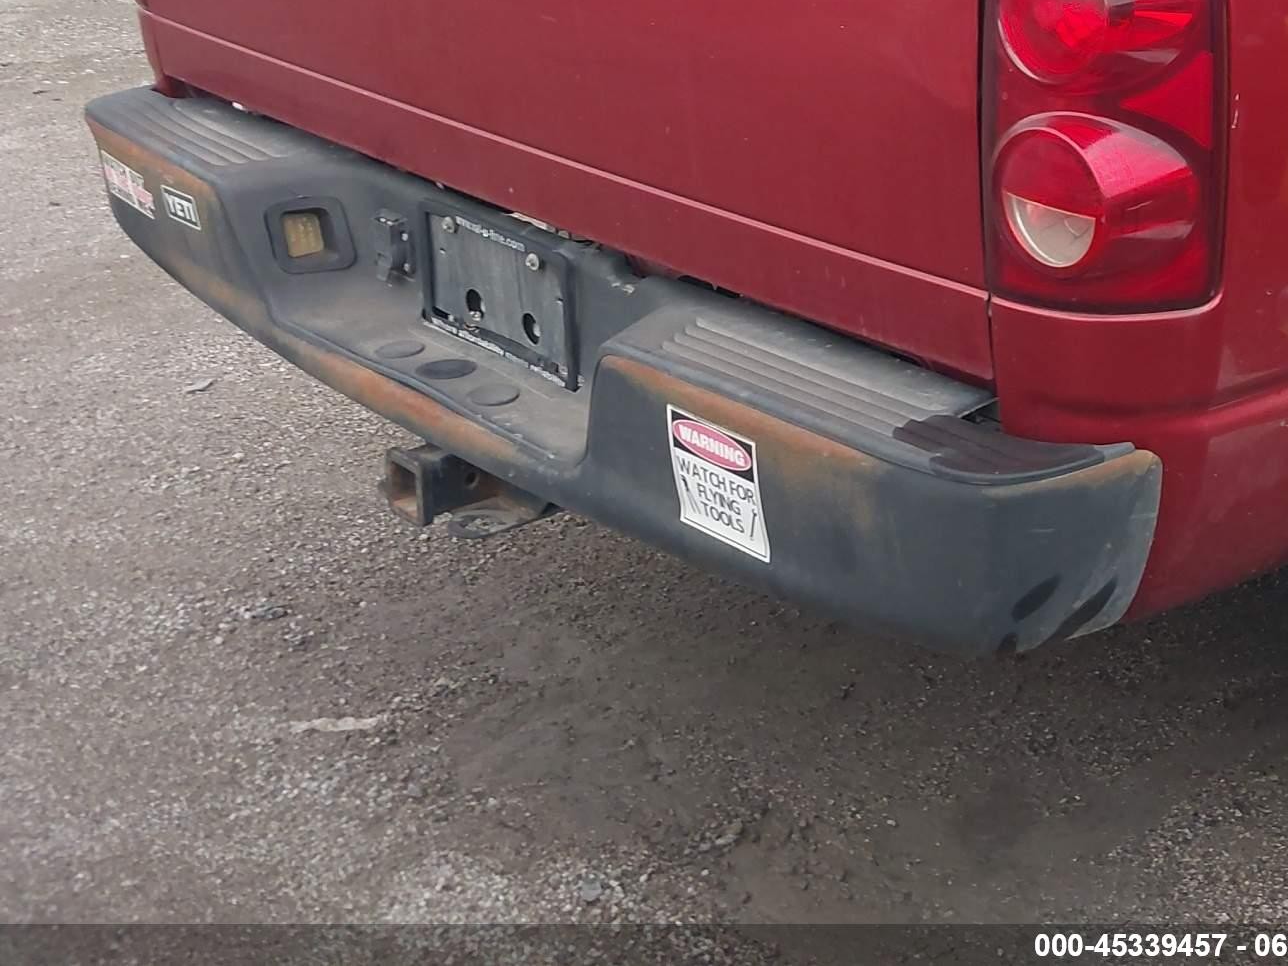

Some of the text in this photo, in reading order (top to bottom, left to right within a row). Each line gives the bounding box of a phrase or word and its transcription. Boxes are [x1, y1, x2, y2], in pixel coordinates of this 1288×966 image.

[678, 424, 746, 468] WARNING
[676, 455, 758, 506] WATCH FOR
[697, 482, 742, 516] FLYING
[700, 500, 746, 534] TOOLS
